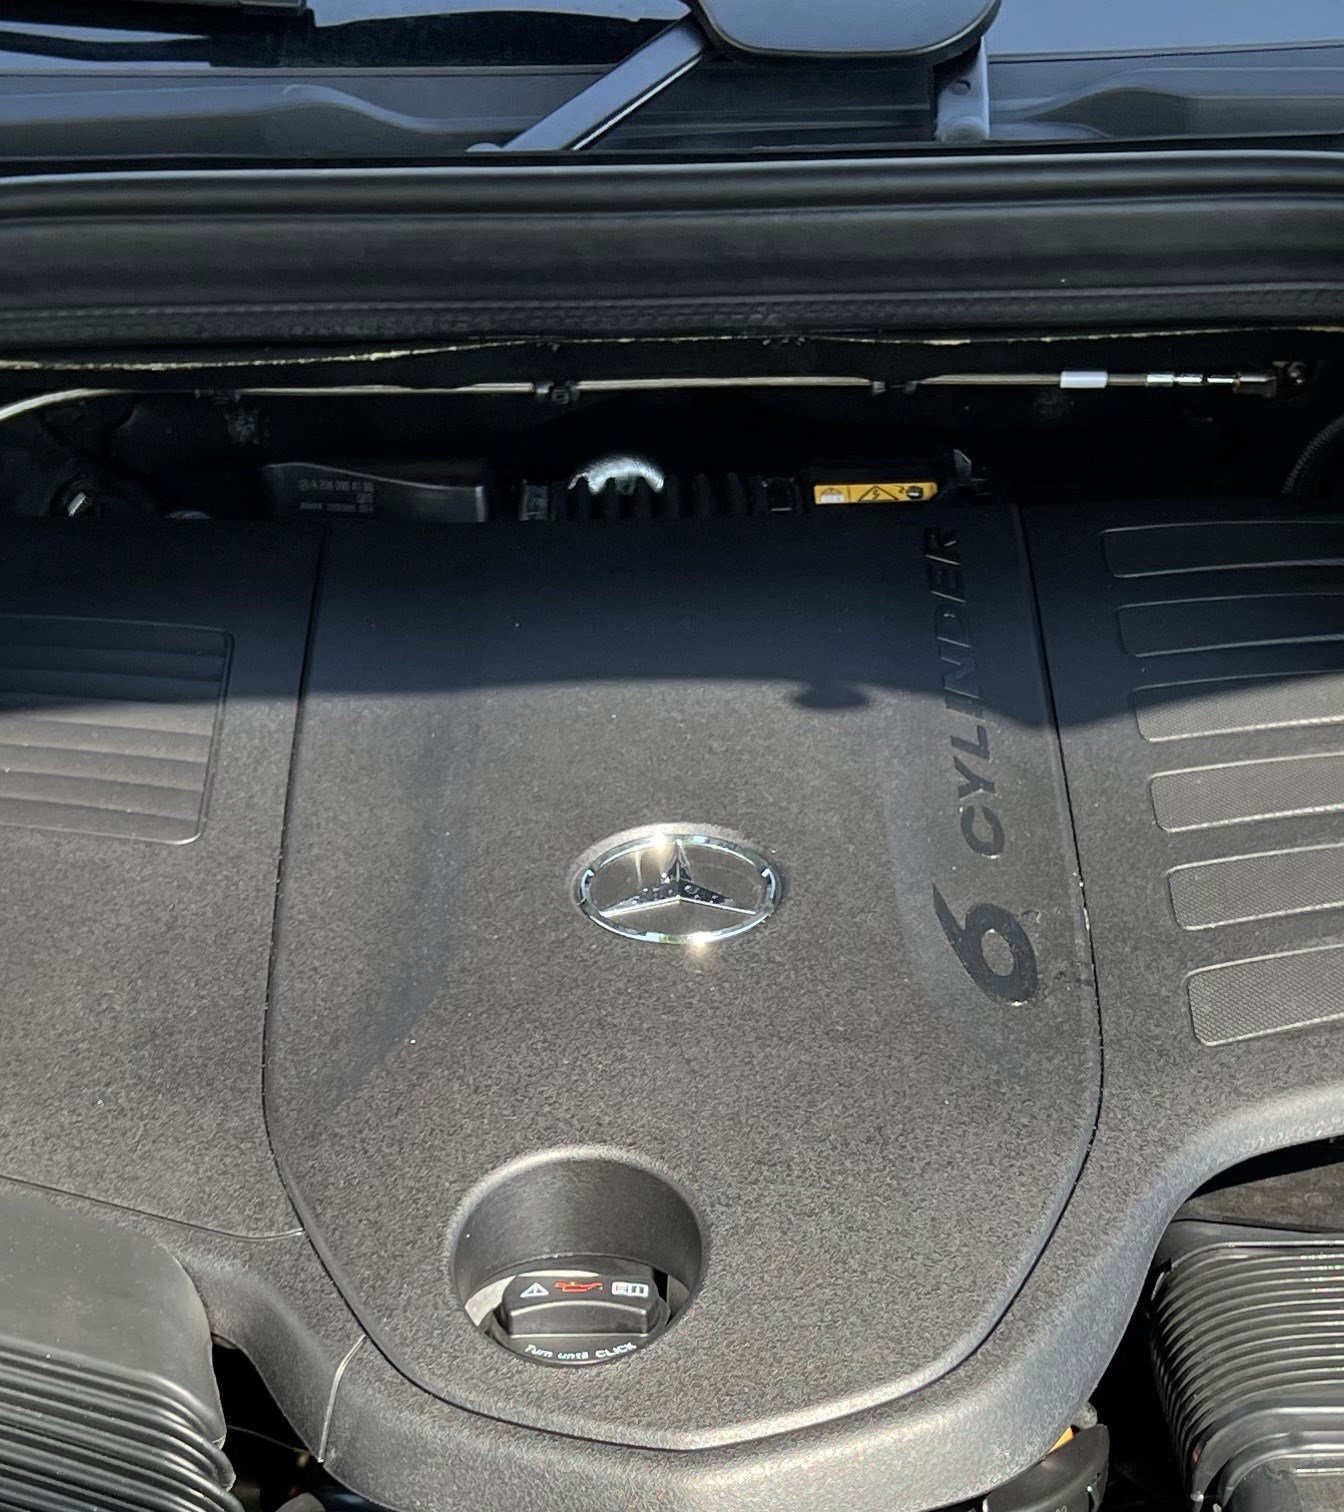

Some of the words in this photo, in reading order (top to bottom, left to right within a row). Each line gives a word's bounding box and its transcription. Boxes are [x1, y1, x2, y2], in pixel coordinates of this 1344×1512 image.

[924, 527, 1006, 859] CYLINDER
[932, 882, 1038, 1006] 6
[525, 1344, 553, 1358] Turn
[557, 1351, 589, 1360] until
[595, 1342, 637, 1358] CLICK
